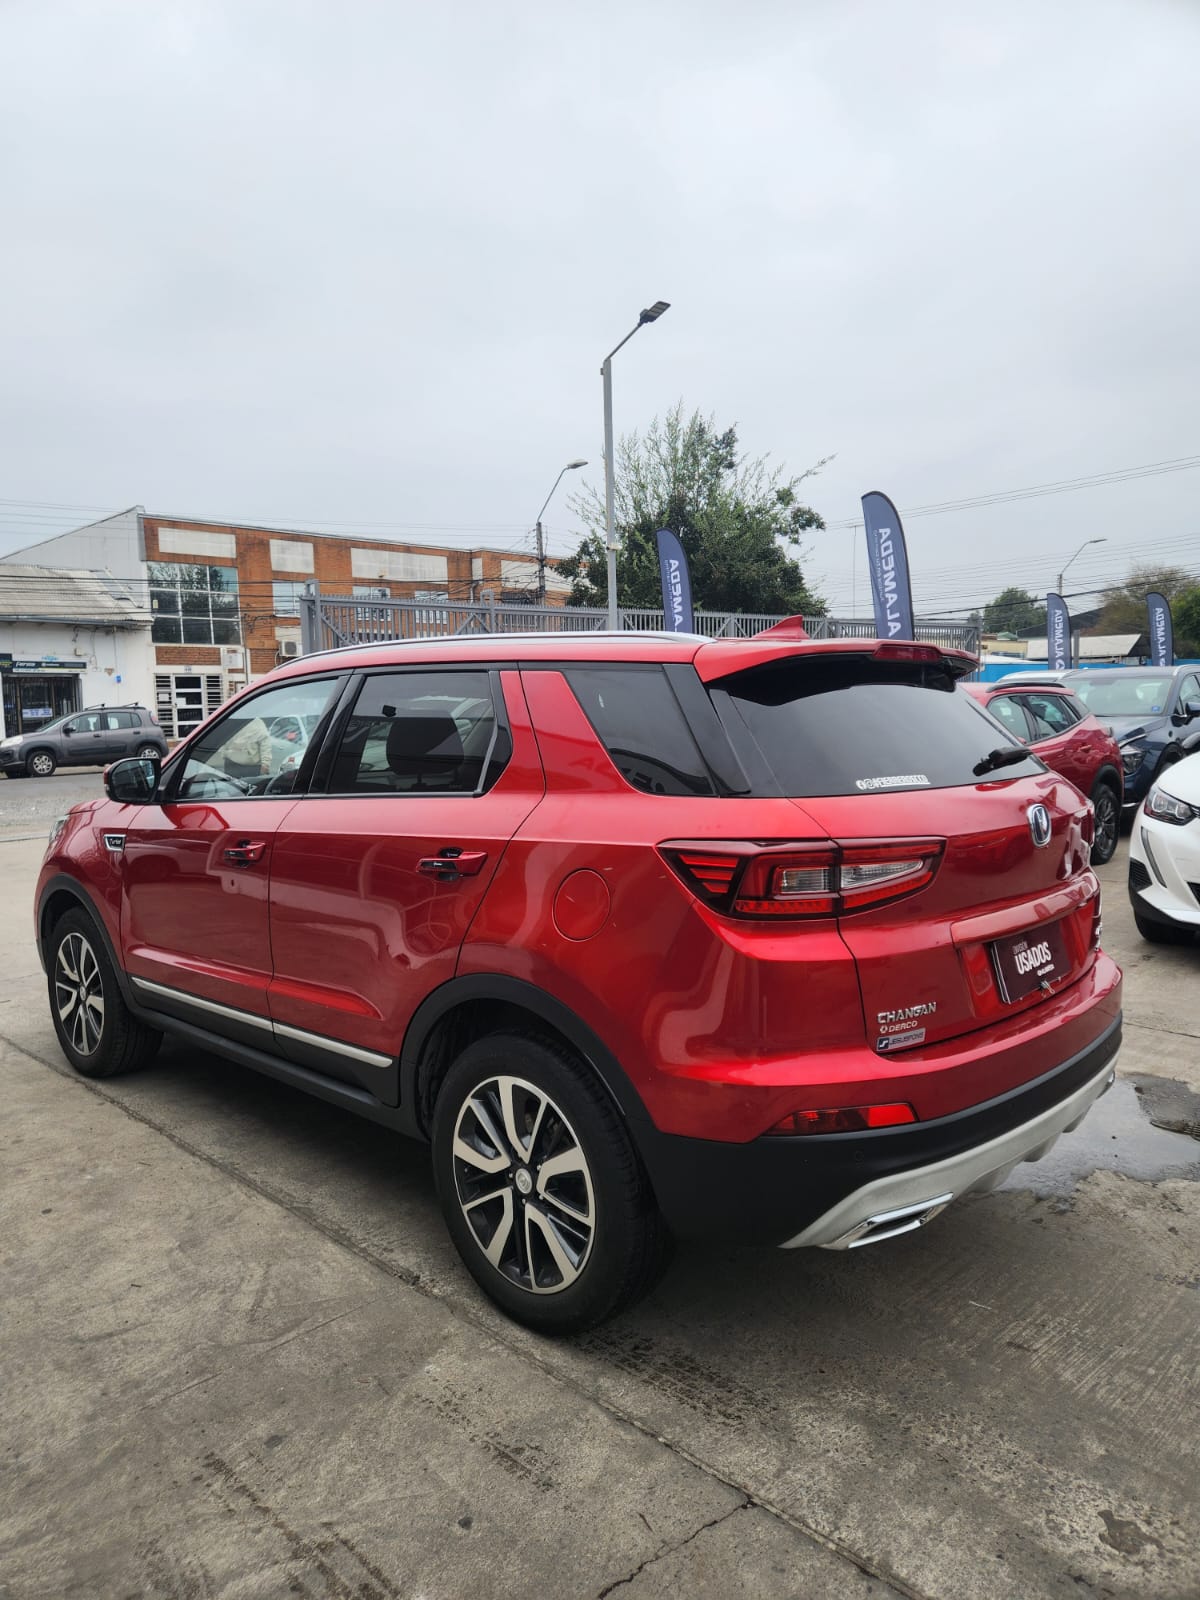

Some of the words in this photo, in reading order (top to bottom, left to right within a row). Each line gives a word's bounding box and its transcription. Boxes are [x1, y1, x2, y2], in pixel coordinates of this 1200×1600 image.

[1014, 941, 1052, 975] USADOS
[877, 1001, 937, 1024] CHANGAN
[888, 1020, 918, 1033] DERCO
